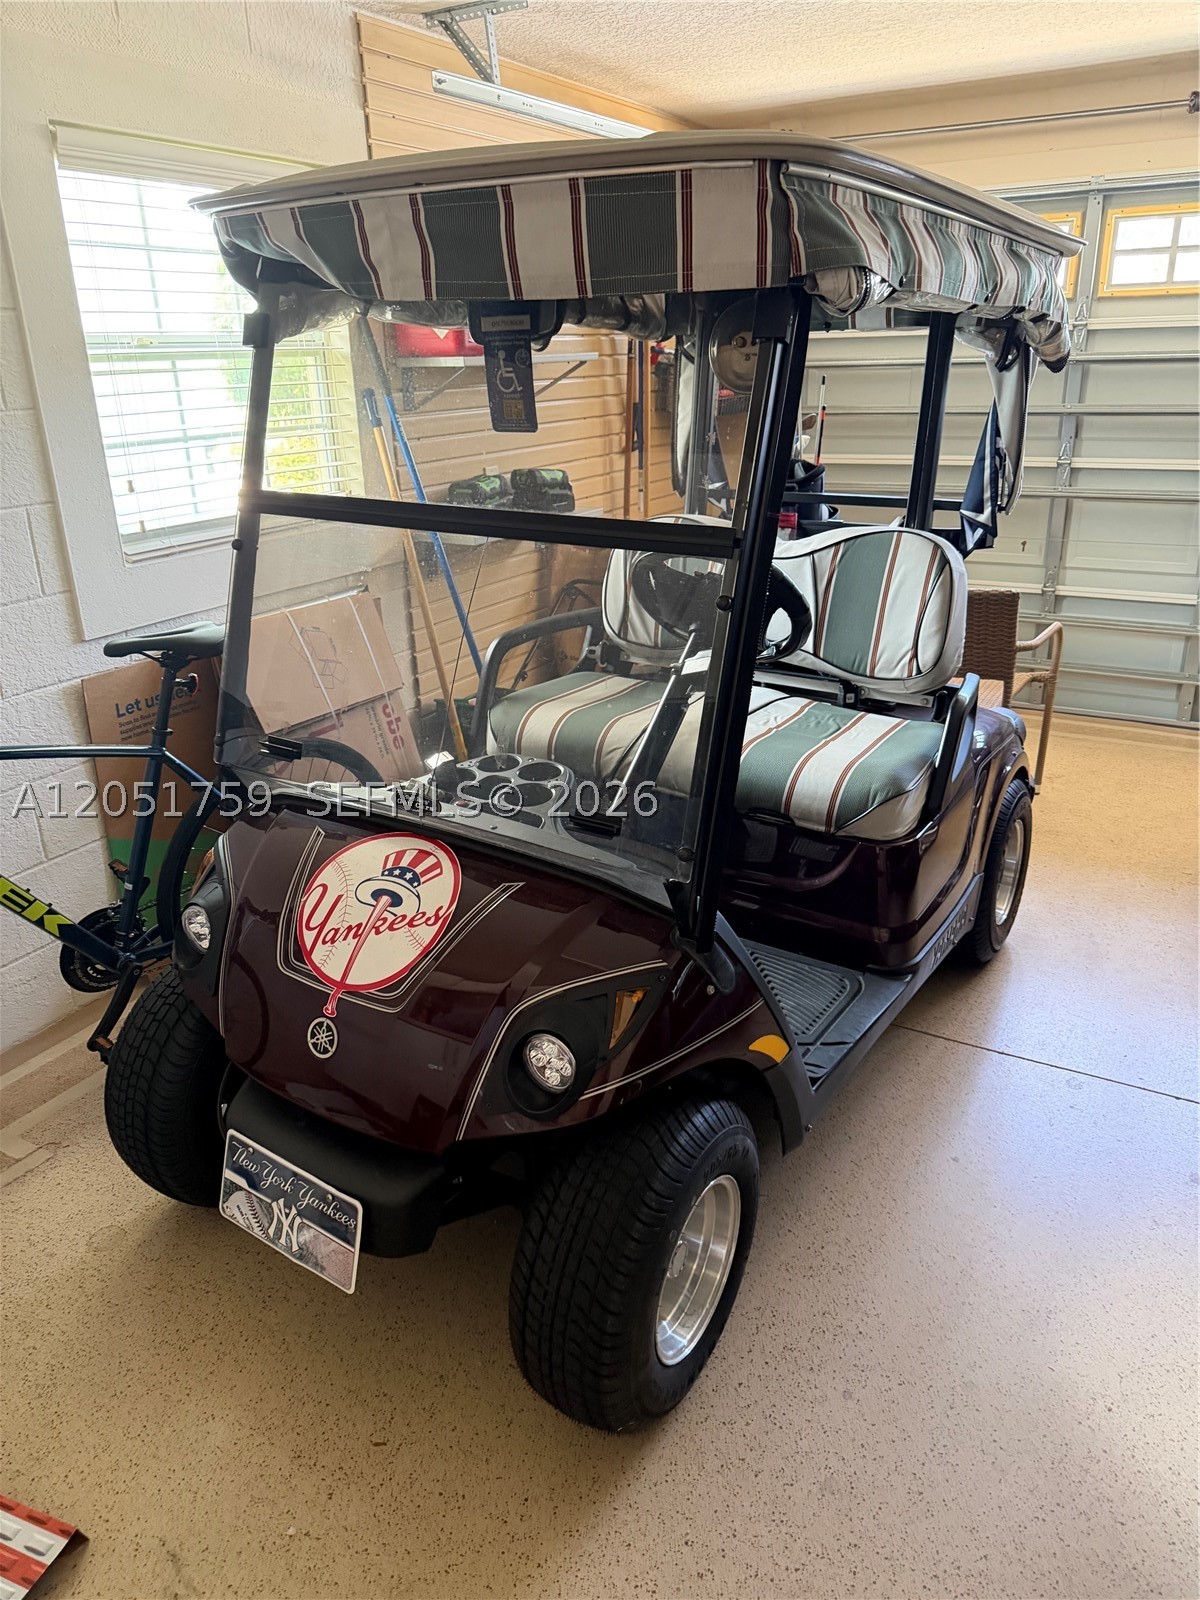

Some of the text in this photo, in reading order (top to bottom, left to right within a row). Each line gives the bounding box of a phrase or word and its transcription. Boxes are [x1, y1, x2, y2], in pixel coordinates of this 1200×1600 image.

[115, 698, 142, 718] Let
[302, 883, 449, 958] Yankees
[231, 1141, 357, 1230] New York Yankees
